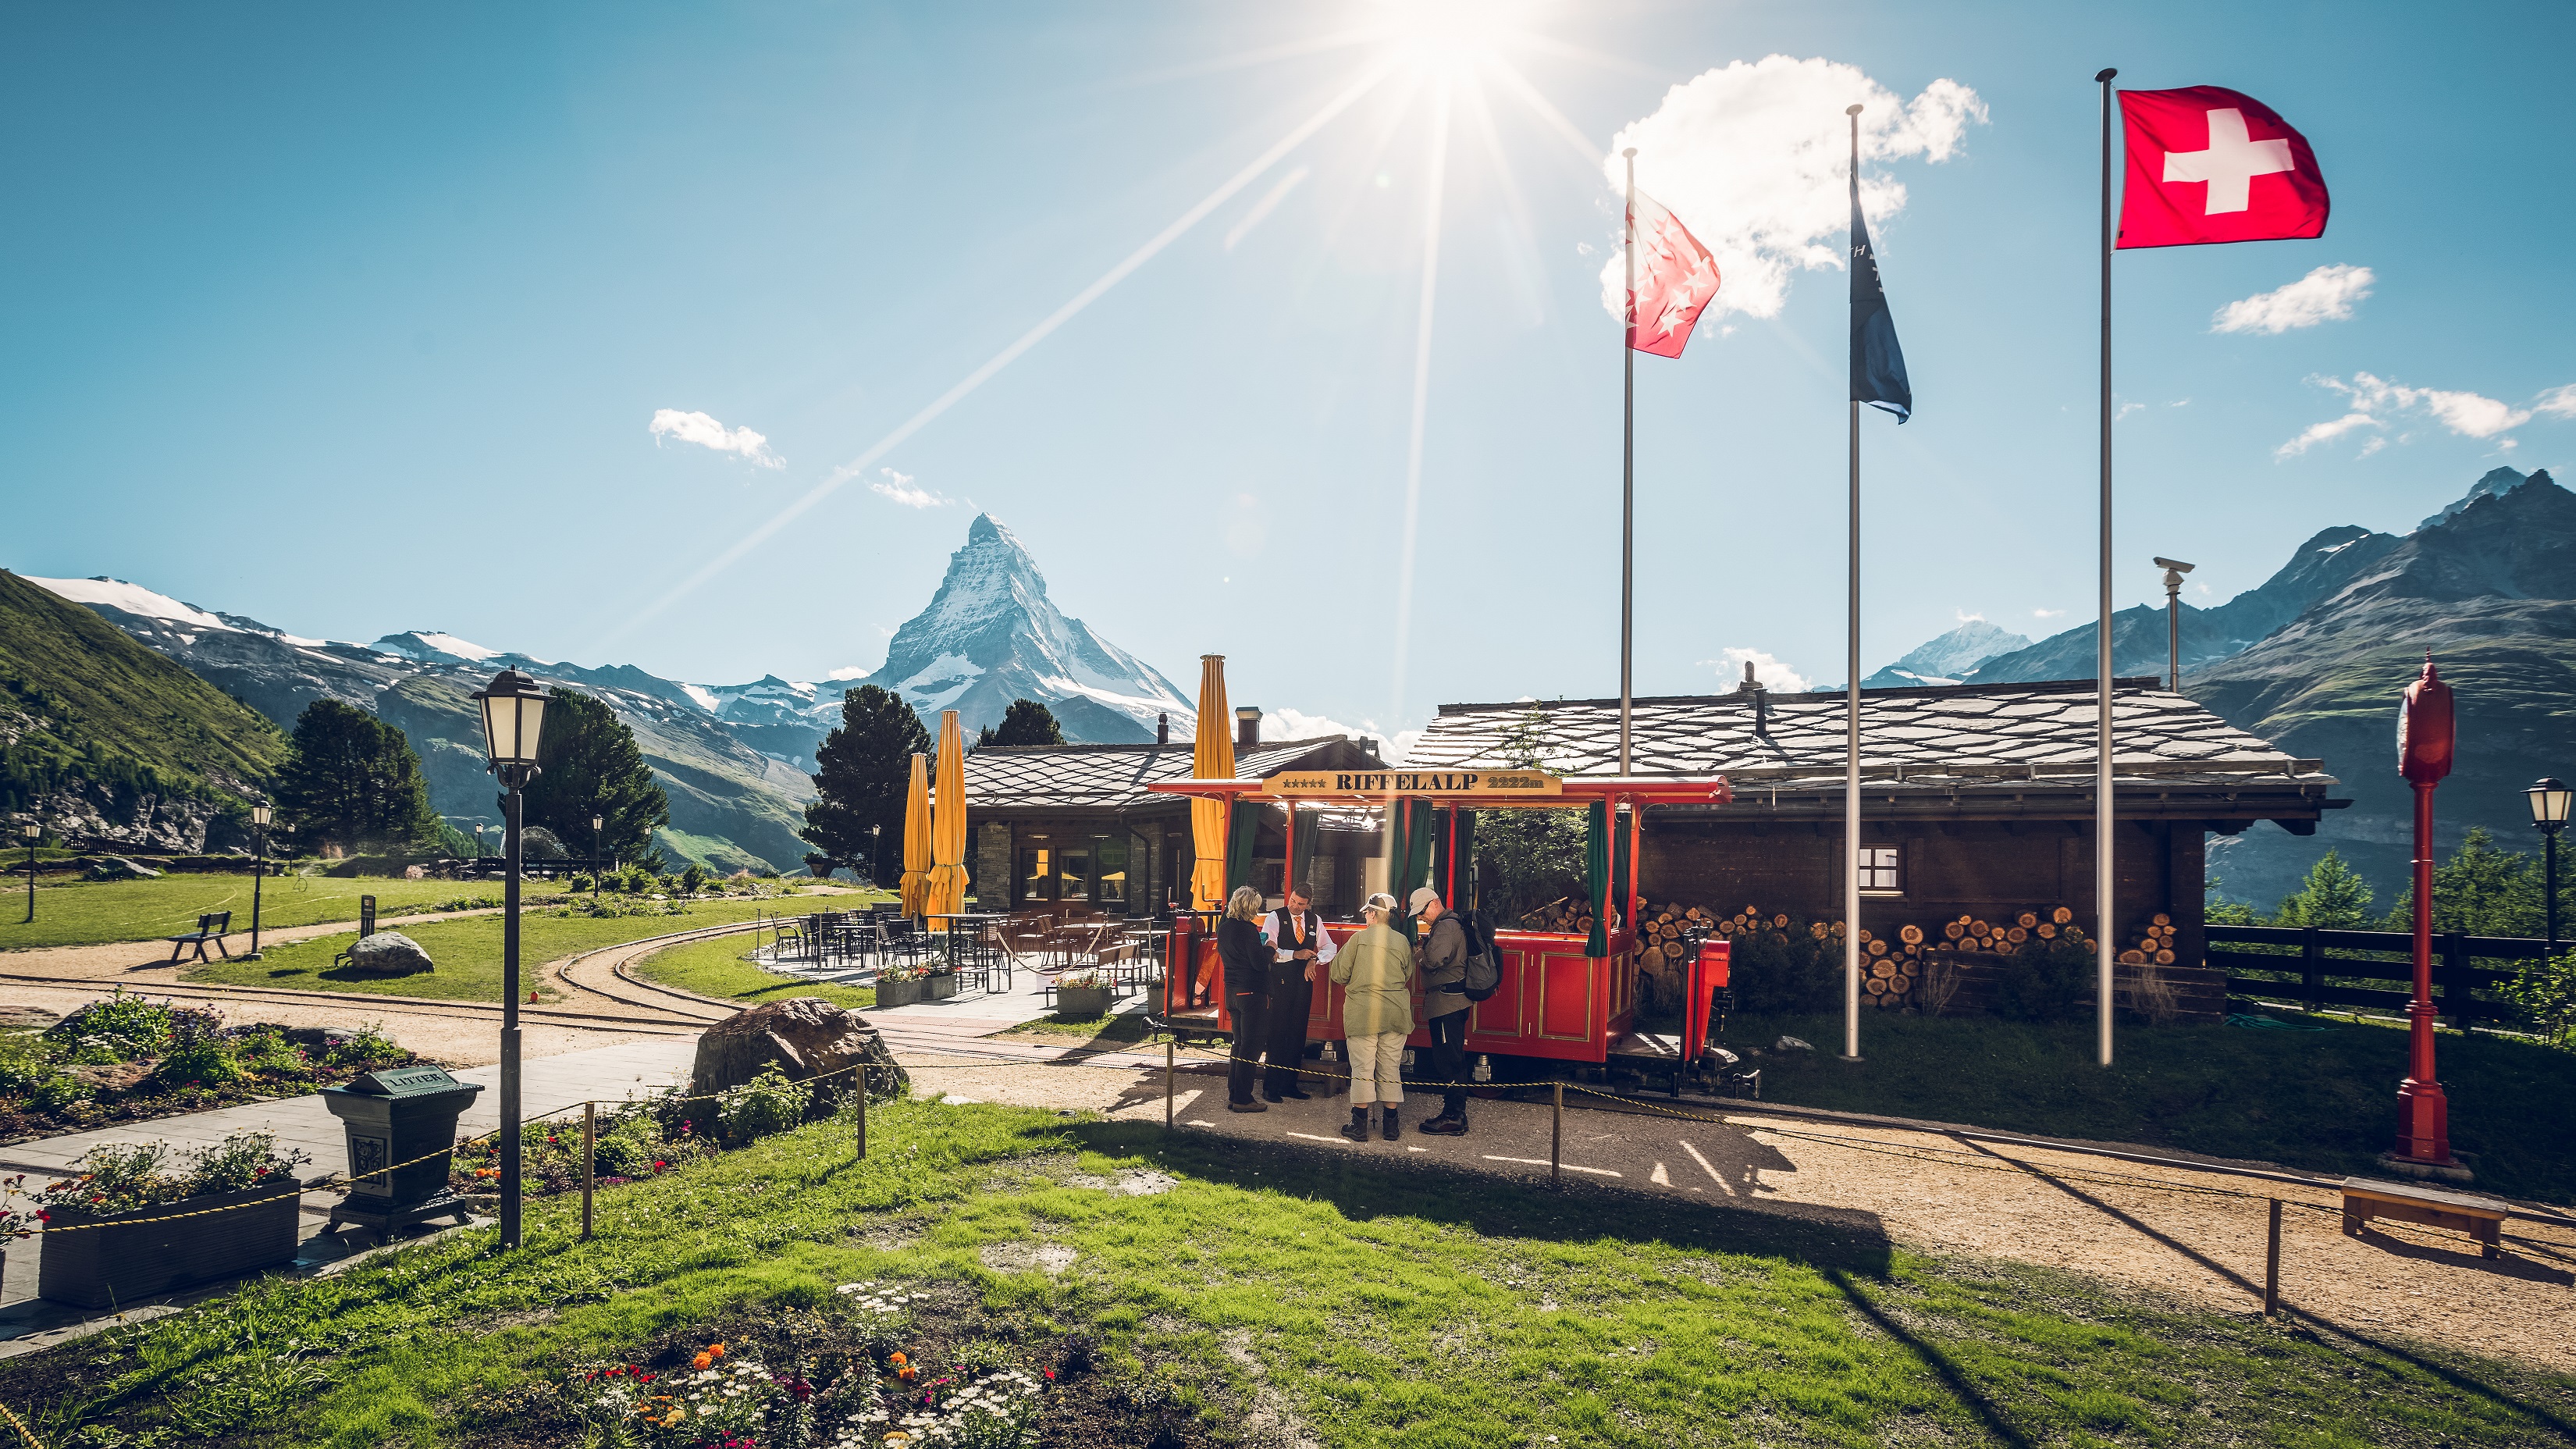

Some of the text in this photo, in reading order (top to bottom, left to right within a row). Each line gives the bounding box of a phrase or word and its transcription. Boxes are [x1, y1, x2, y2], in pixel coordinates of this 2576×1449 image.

[1335, 774, 1544, 790] RIFFELALP 2222m
[390, 1073, 443, 1087] LITTER
